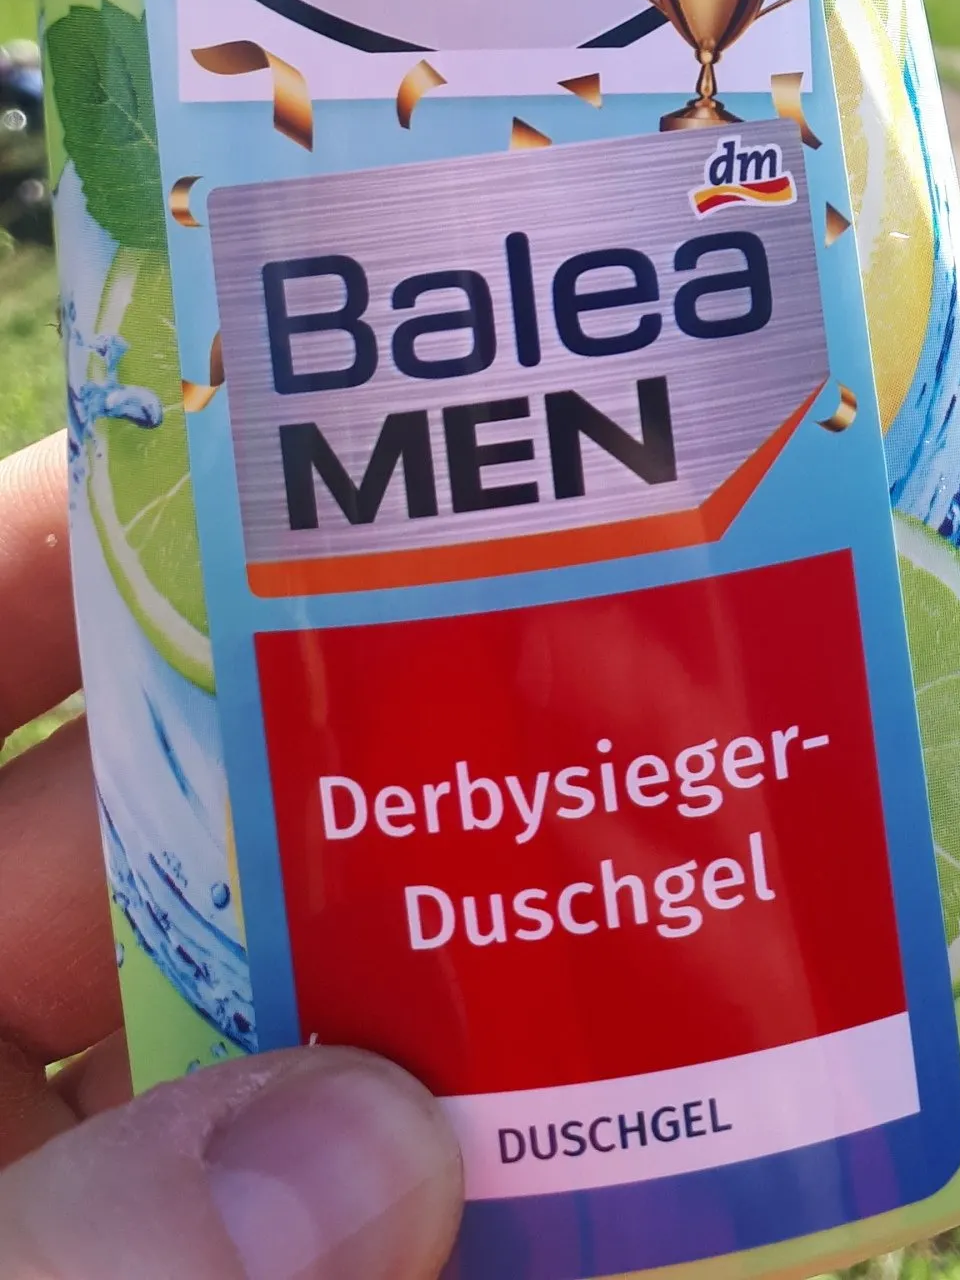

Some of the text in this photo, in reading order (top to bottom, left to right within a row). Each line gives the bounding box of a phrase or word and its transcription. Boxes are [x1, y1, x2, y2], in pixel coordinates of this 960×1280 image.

[708, 140, 778, 186] dm
[261, 229, 774, 396] Balea
[278, 375, 678, 531] MEN
[319, 722, 832, 843] Derbysieger-
[403, 833, 778, 952] Duschgel
[496, 1096, 732, 1167] DUSCHGEL
